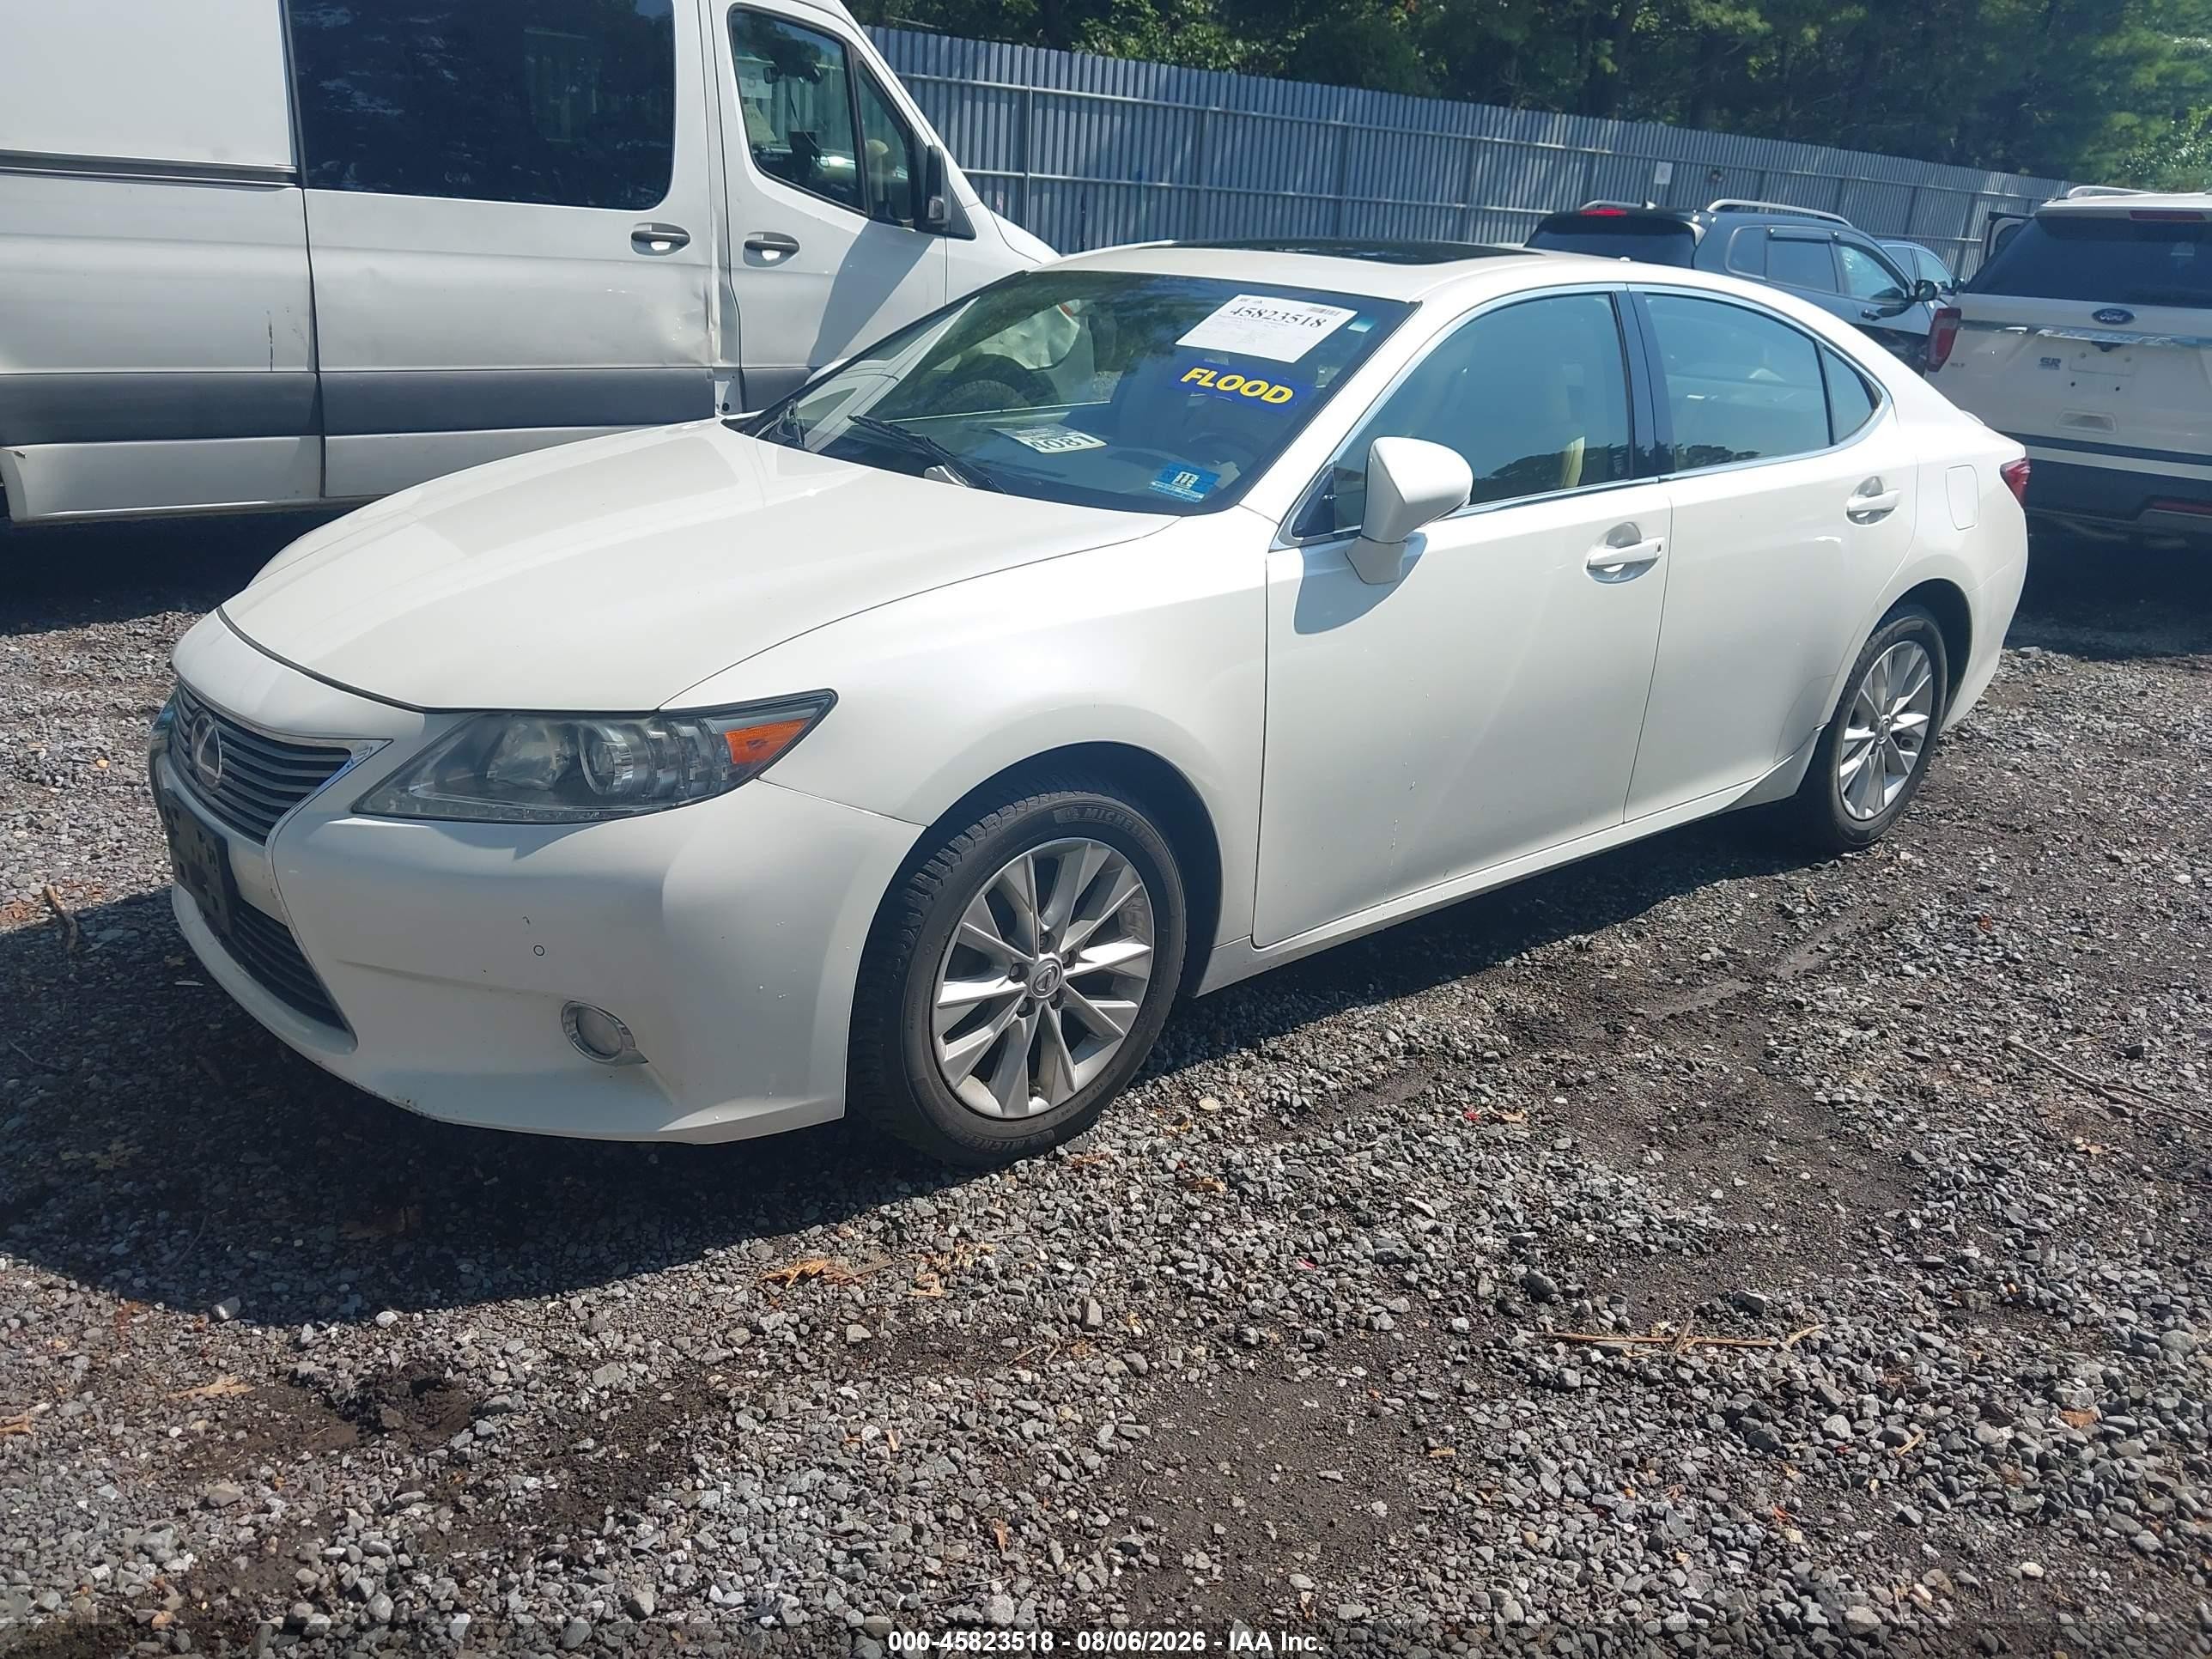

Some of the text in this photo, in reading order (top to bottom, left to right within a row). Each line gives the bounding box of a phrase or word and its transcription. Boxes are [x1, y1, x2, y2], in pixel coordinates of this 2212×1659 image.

[1230, 307, 1328, 328] 45823518
[1180, 367, 1294, 404] FLOOD
[1029, 435, 1096, 450] 4081
